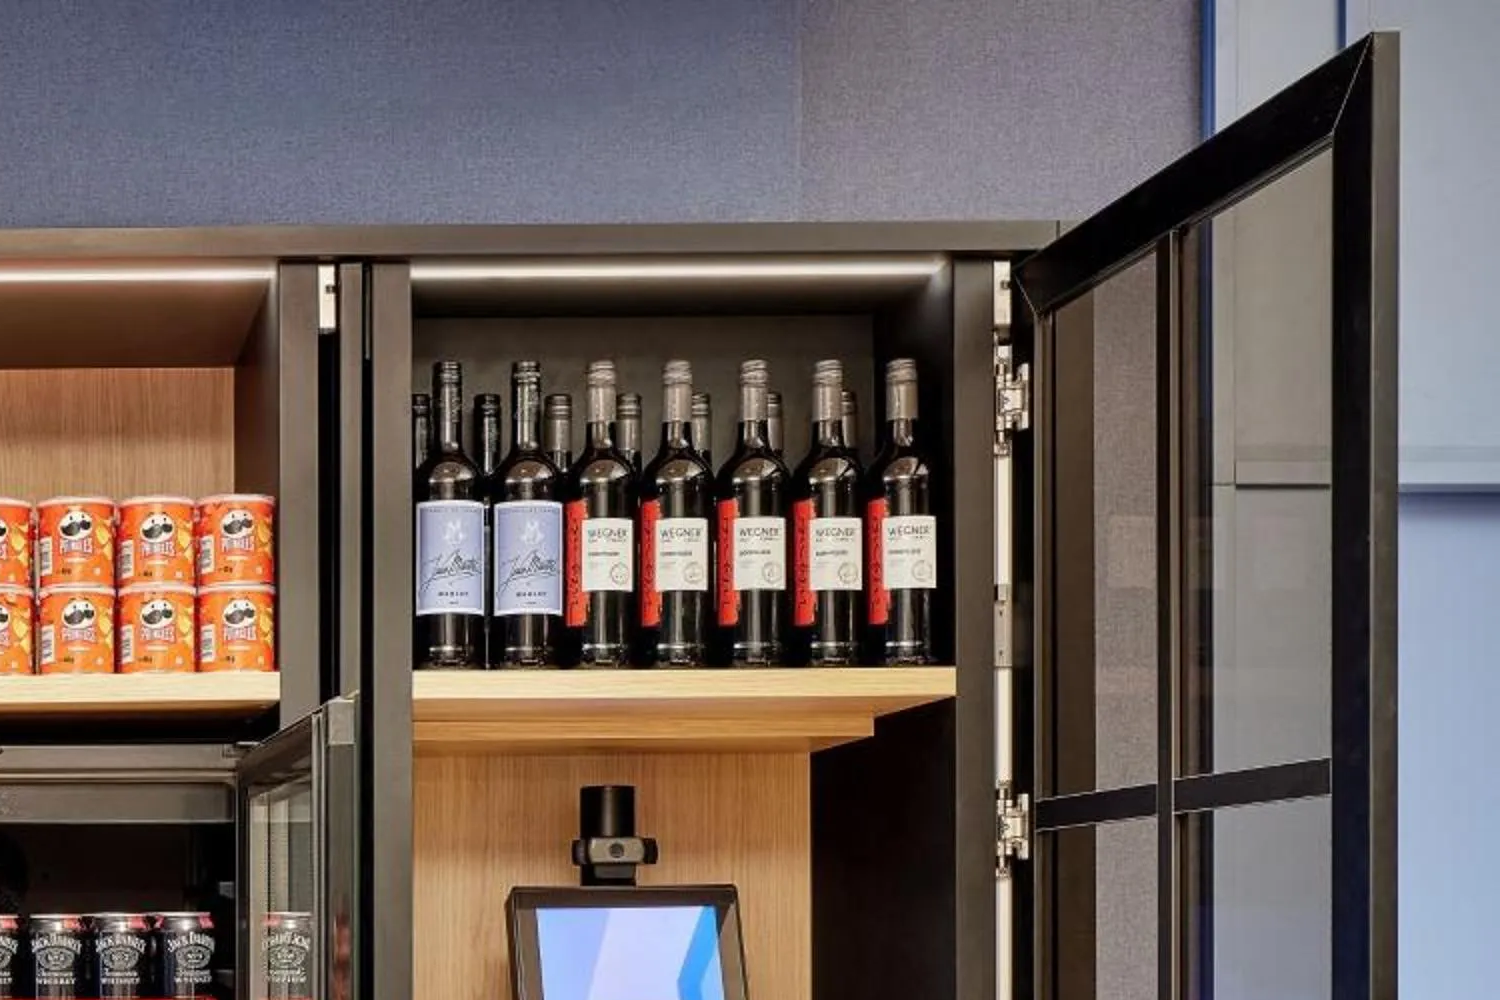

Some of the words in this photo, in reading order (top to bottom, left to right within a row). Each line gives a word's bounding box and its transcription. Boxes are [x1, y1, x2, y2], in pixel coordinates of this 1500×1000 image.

[588, 527, 627, 537] WEGNER
[661, 527, 702, 537] WEGNER
[739, 527, 780, 537] WEGNER
[816, 527, 855, 537] WEGNER
[888, 525, 932, 536] WEGNER
